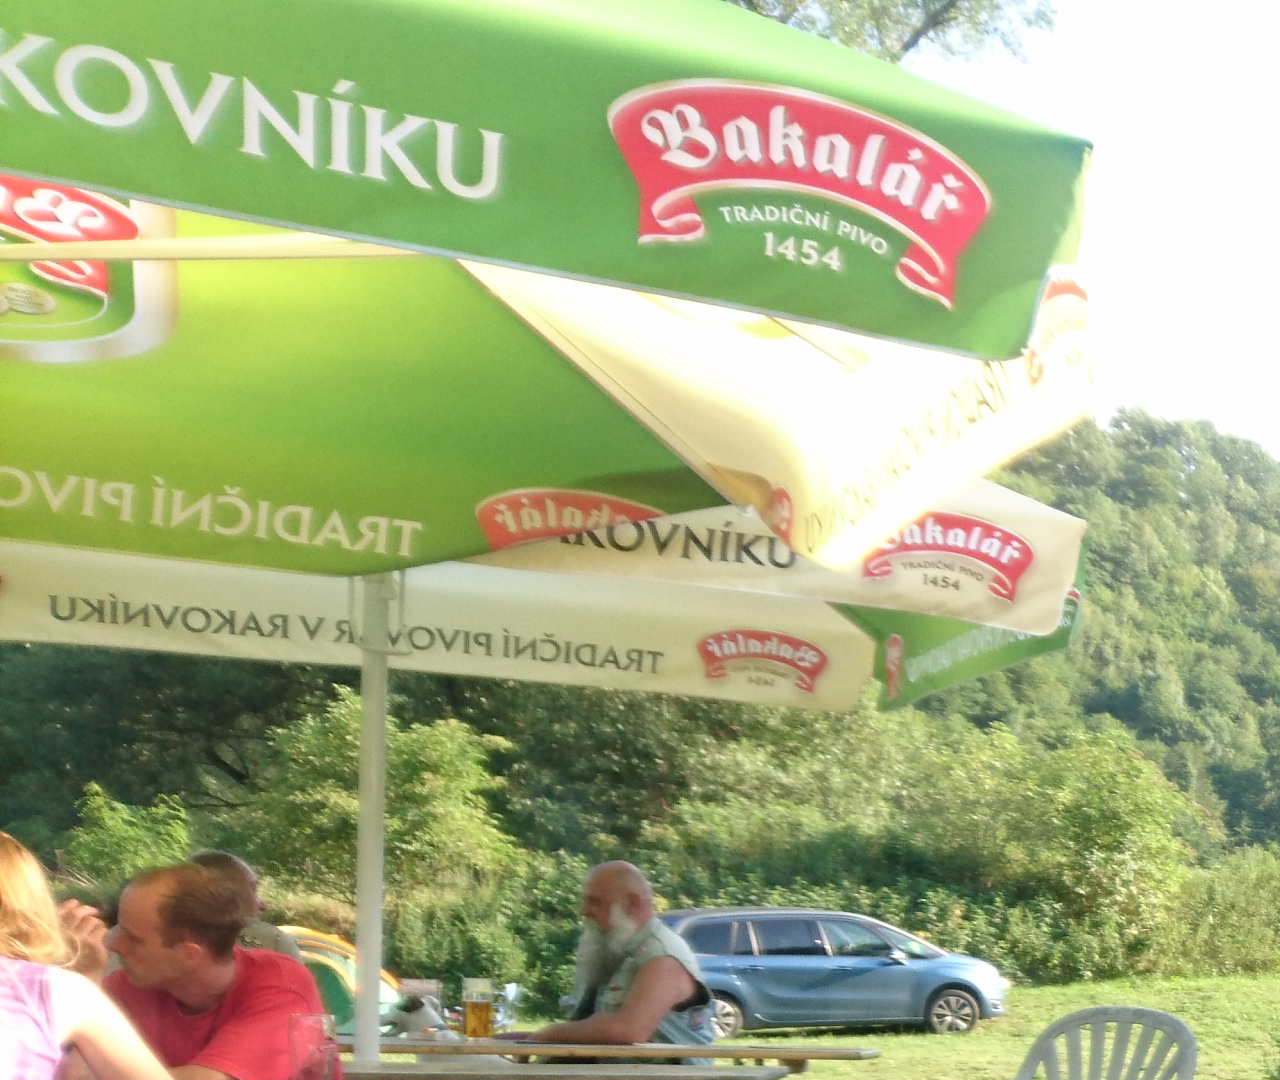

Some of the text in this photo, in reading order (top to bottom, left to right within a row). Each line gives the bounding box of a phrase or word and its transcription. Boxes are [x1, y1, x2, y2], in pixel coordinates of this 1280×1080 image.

[0, 29, 505, 200] KOVNÍKU
[641, 104, 963, 222] Bakalář
[719, 204, 888, 255] TRADIČNÍ PIVO
[763, 232, 842, 271] 1454
[560, 520, 796, 569] OVNÍKU
[922, 573, 961, 590] 1454
